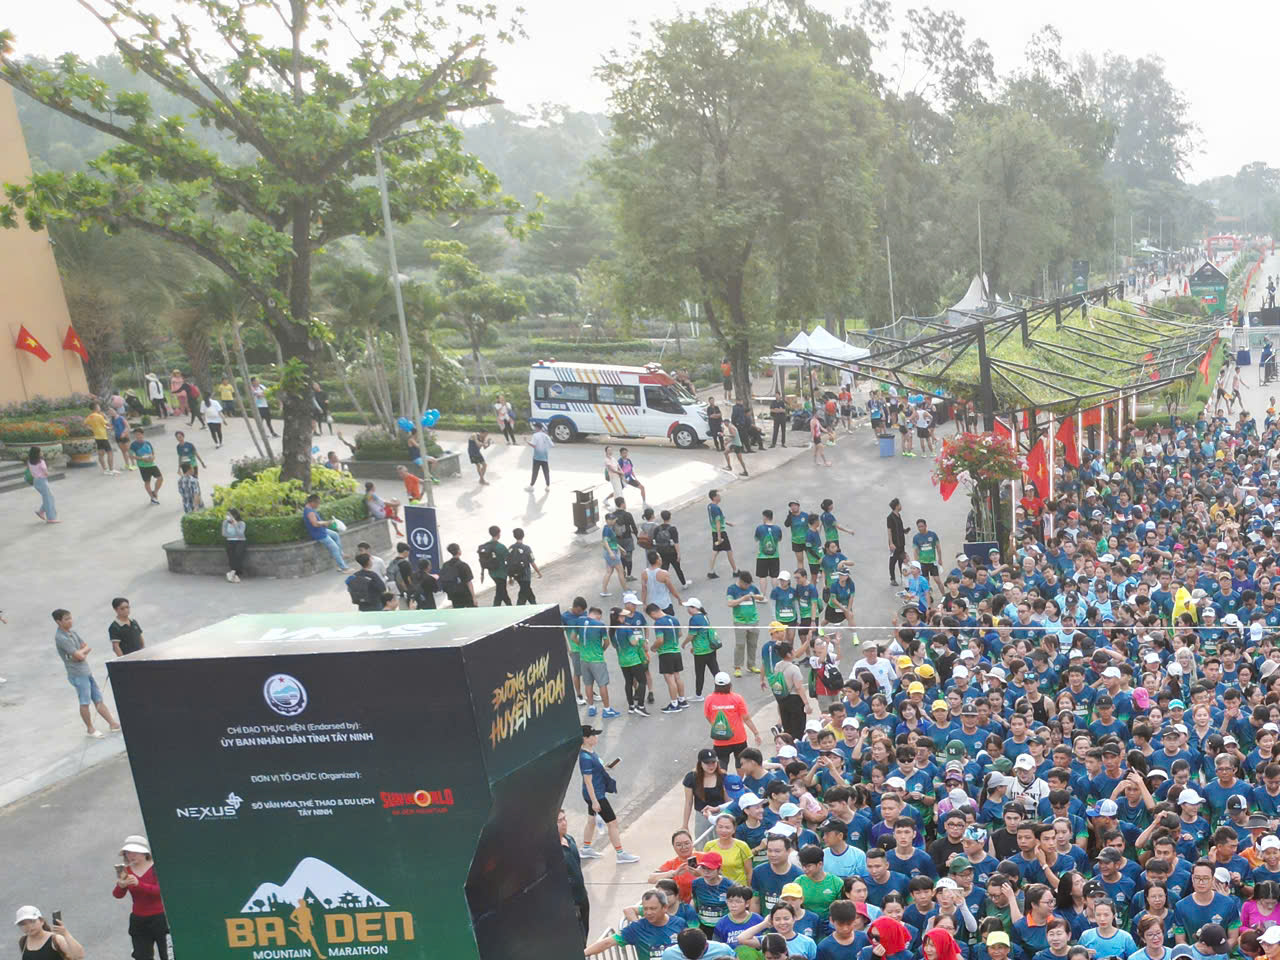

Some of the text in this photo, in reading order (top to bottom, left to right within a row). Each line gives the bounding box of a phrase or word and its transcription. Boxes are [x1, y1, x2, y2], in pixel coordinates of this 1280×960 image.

[307, 722, 346, 732] (Endorsed
[236, 737, 256, 746] BAN
[258, 734, 285, 745] NHÂN
[286, 734, 306, 744] DÂN
[331, 732, 348, 742] TÂY
[350, 733, 374, 741] NINH
[344, 798, 356, 806] DU
[176, 806, 237, 820] NEXUS
[225, 911, 415, 948] BA DEN
[253, 945, 388, 960] MOUNTAIN MARATHON
